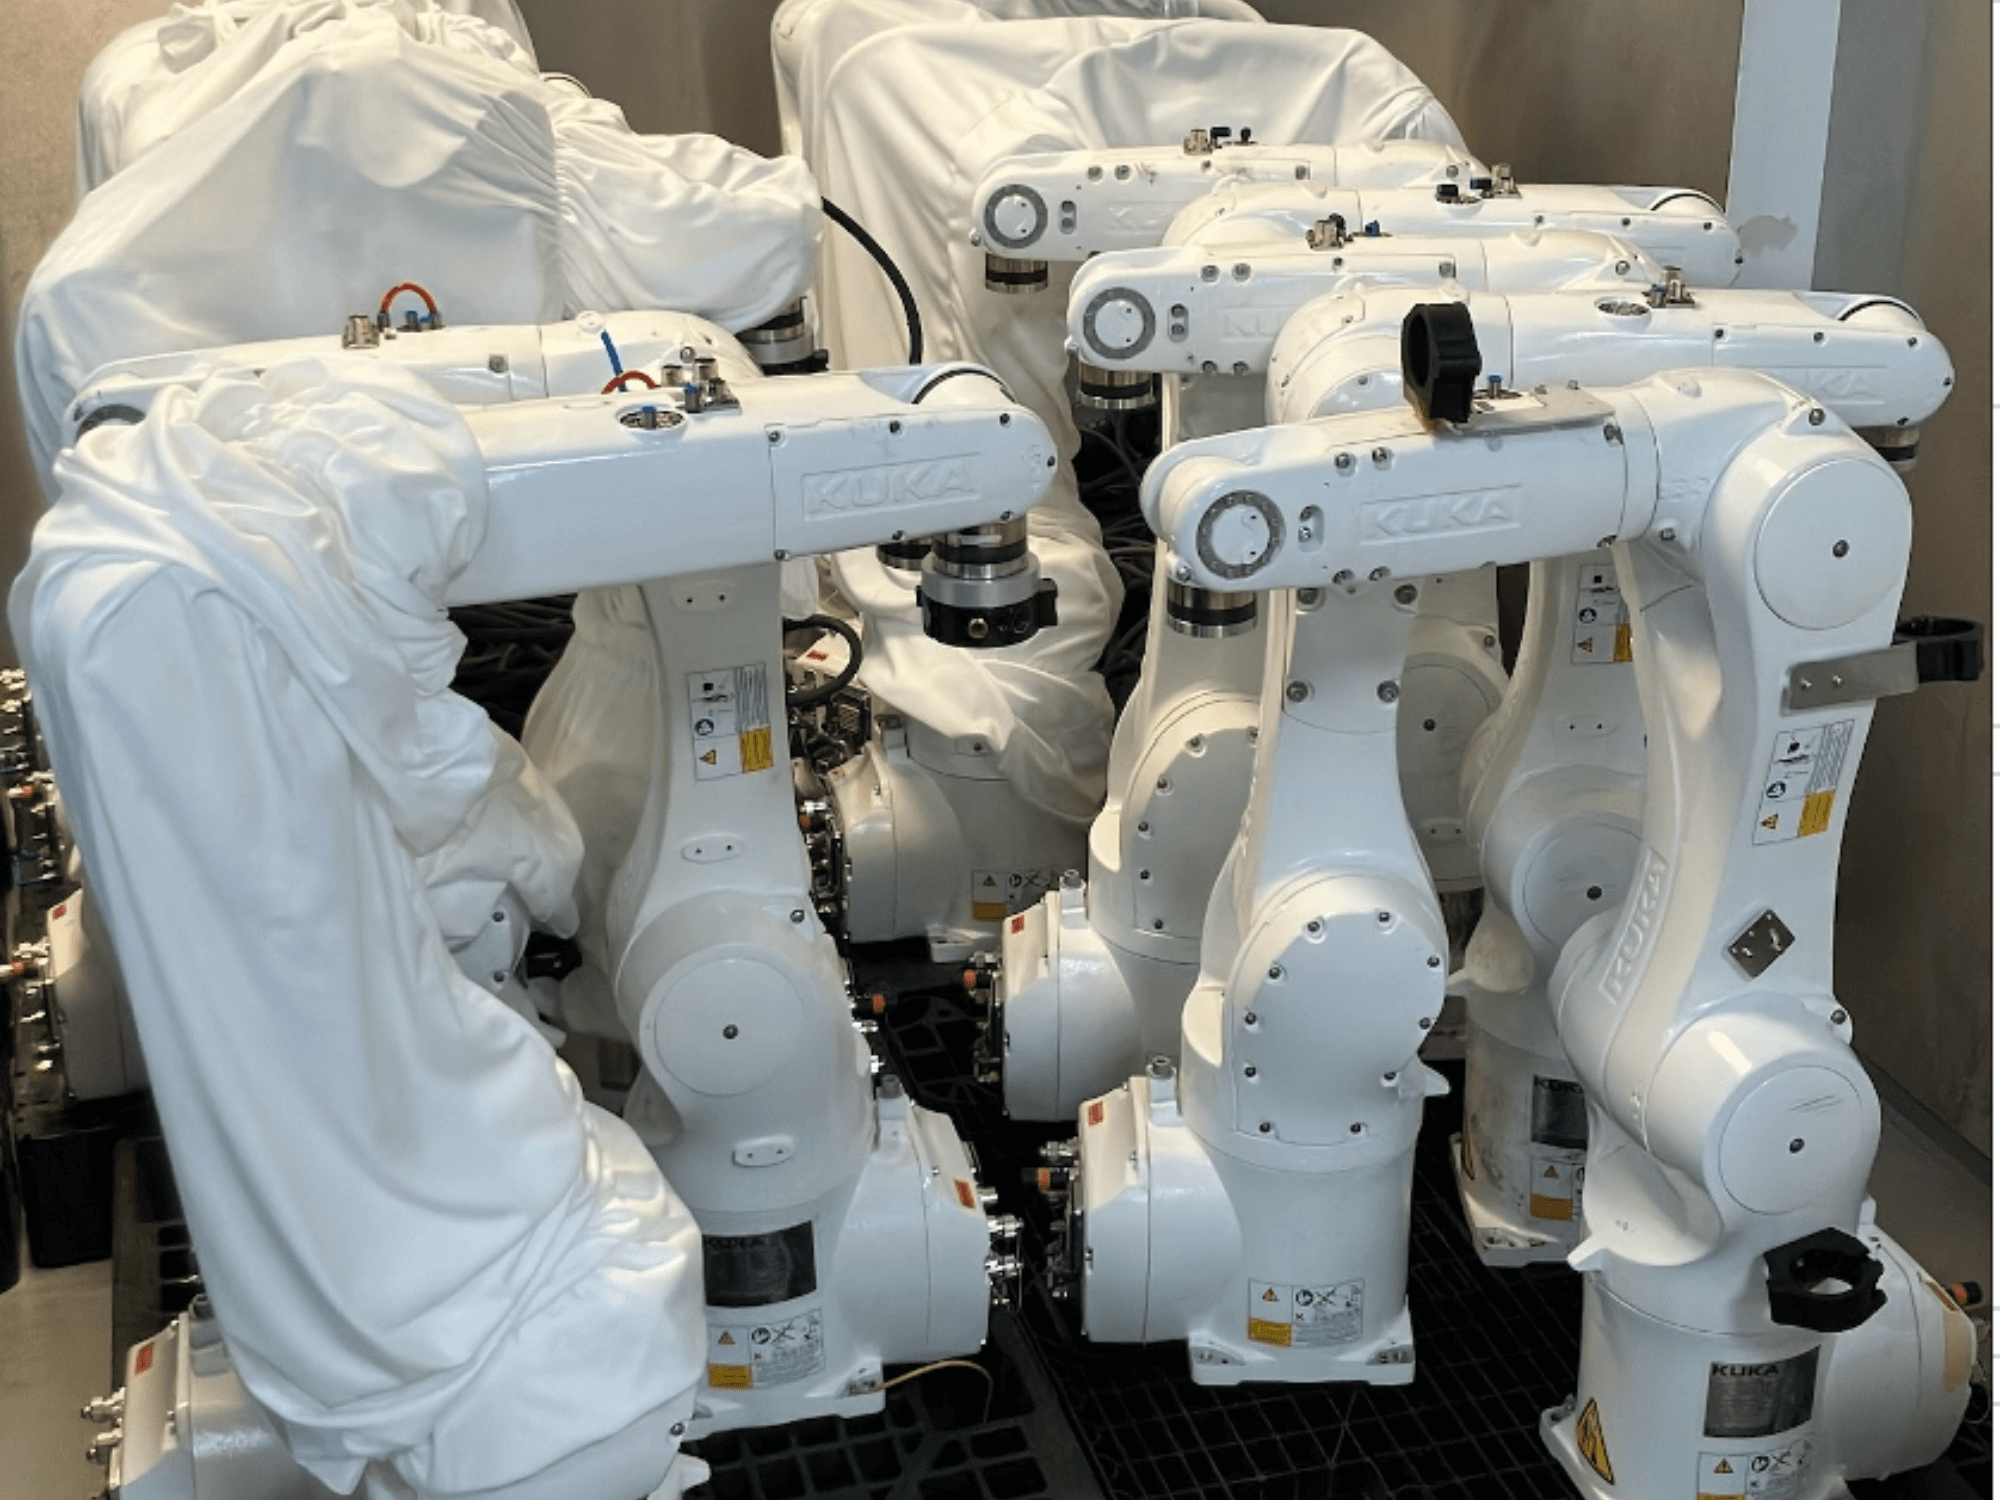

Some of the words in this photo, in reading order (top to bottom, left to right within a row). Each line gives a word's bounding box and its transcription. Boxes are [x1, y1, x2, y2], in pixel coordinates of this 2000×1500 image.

[806, 457, 977, 514] KUKA
[1362, 491, 1514, 537] KUKA
[1603, 860, 1668, 997] KUKA
[1710, 1363, 1780, 1377] KUKA
